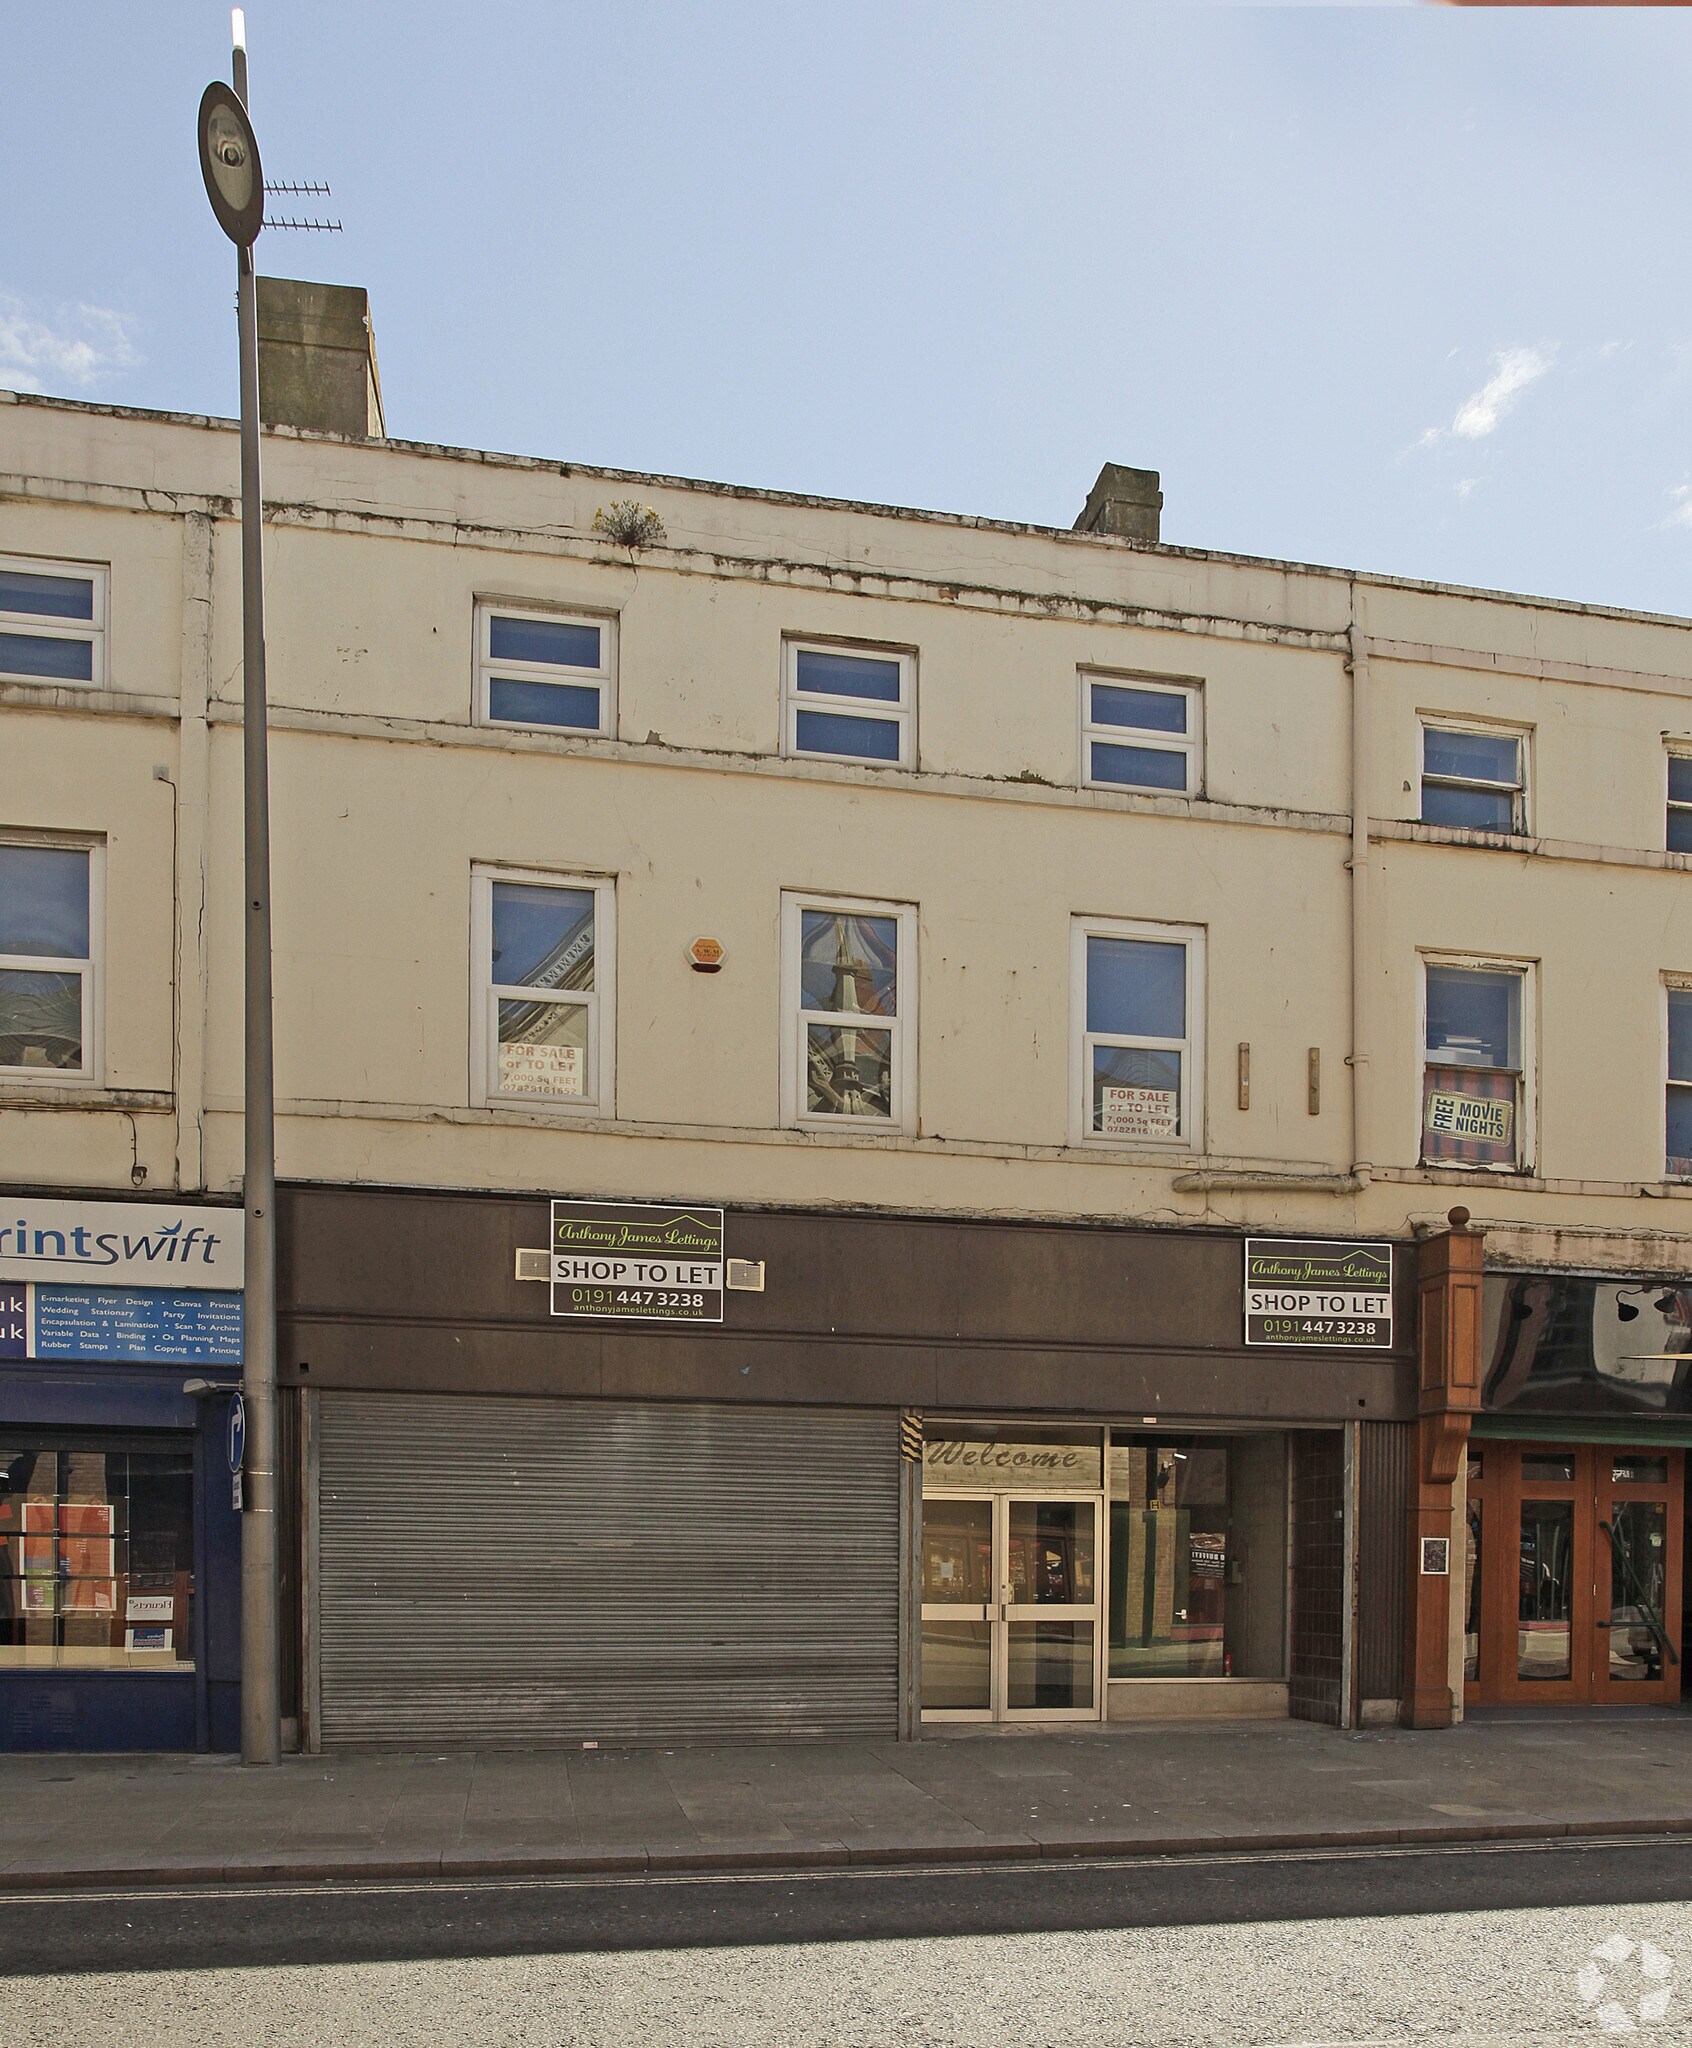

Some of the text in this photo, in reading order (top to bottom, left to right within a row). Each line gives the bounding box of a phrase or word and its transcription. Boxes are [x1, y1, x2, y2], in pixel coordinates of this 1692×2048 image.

[506, 1044, 575, 1060] FOR SALE
[506, 1059, 575, 1072] or TO LET
[503, 1073, 577, 1085] 7,000 Sq FEET
[1110, 1089, 1170, 1102] FOR SALE
[1109, 1103, 1170, 1115] or TO LET
[1433, 1098, 1455, 1130] FREE
[1459, 1102, 1503, 1122] MOVIE
[1107, 1116, 1172, 1127] 7,000 Sq FEET
[1455, 1117, 1504, 1138] NIGHTS
[558, 1223, 719, 1251] Anthony James Lettings
[557, 1260, 718, 1285] SHOP TO LET
[1252, 1259, 1388, 1283] Anthony James Lettings
[41, 1295, 241, 1311] E-marketing Flyer Design Canvas Printing
[573, 1304, 704, 1317] anthonyjameslettings.co.uk
[1251, 1294, 1388, 1314] SHOP TO LET
[41, 1306, 241, 1321] Wedding Stationary Party Invitations
[41, 1318, 96, 1327] Encapsulation
[114, 1321, 159, 1329] Lamination
[196, 1323, 206, 1331] To
[209, 1324, 241, 1332] Archive
[41, 1329, 74, 1337] Variable
[116, 1332, 146, 1341] Binding
[181, 1334, 214, 1343] Planning
[220, 1336, 241, 1344] Maps
[1265, 1334, 1375, 1344] anthonyjameslettings.co.uk
[80, 1342, 108, 1351] Stamps
[154, 1345, 187, 1354] Copying
[210, 1347, 241, 1356] Printing
[926, 1438, 1079, 1469] Welcome
